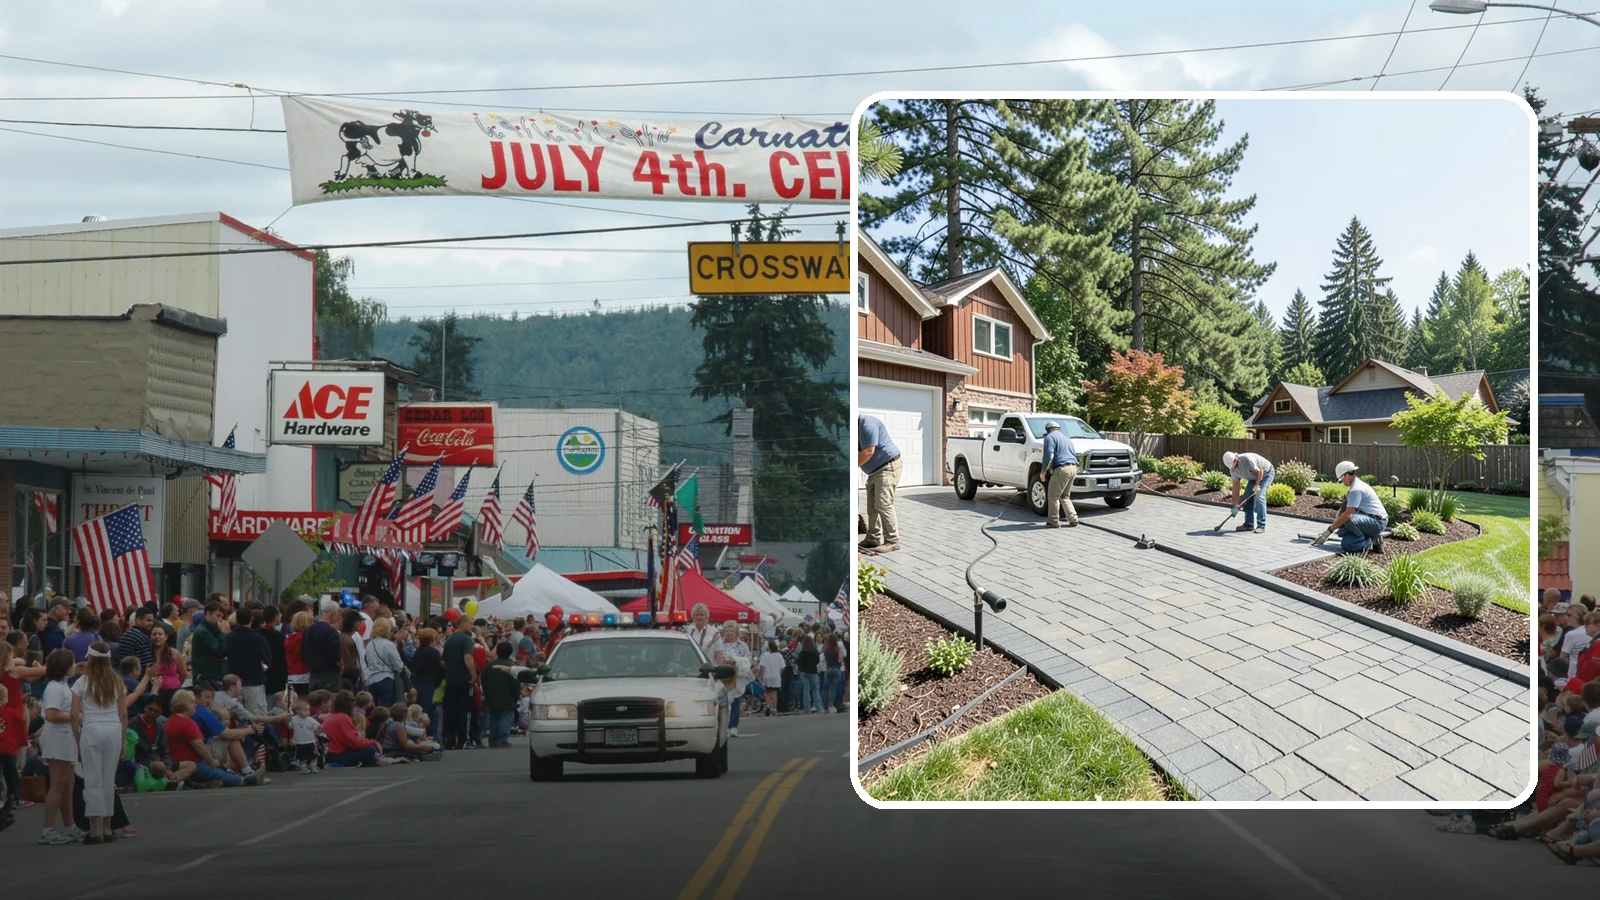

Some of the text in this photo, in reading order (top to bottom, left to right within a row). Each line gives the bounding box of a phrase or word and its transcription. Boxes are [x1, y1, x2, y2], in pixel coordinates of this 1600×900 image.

[481, 141, 604, 192] JULY
[633, 150, 746, 198] 4th.
[697, 254, 850, 280] CROSSWA
[283, 380, 373, 419] ACE
[405, 409, 452, 422] CEDAR
[284, 421, 370, 436] Hardware
[416, 428, 477, 447] Coca-Cola
[354, 467, 386, 480] Simpl
[83, 485, 155, 495] St. Vincent de Paul
[688, 527, 741, 535] CRNATION
[699, 535, 730, 543] GLASS
